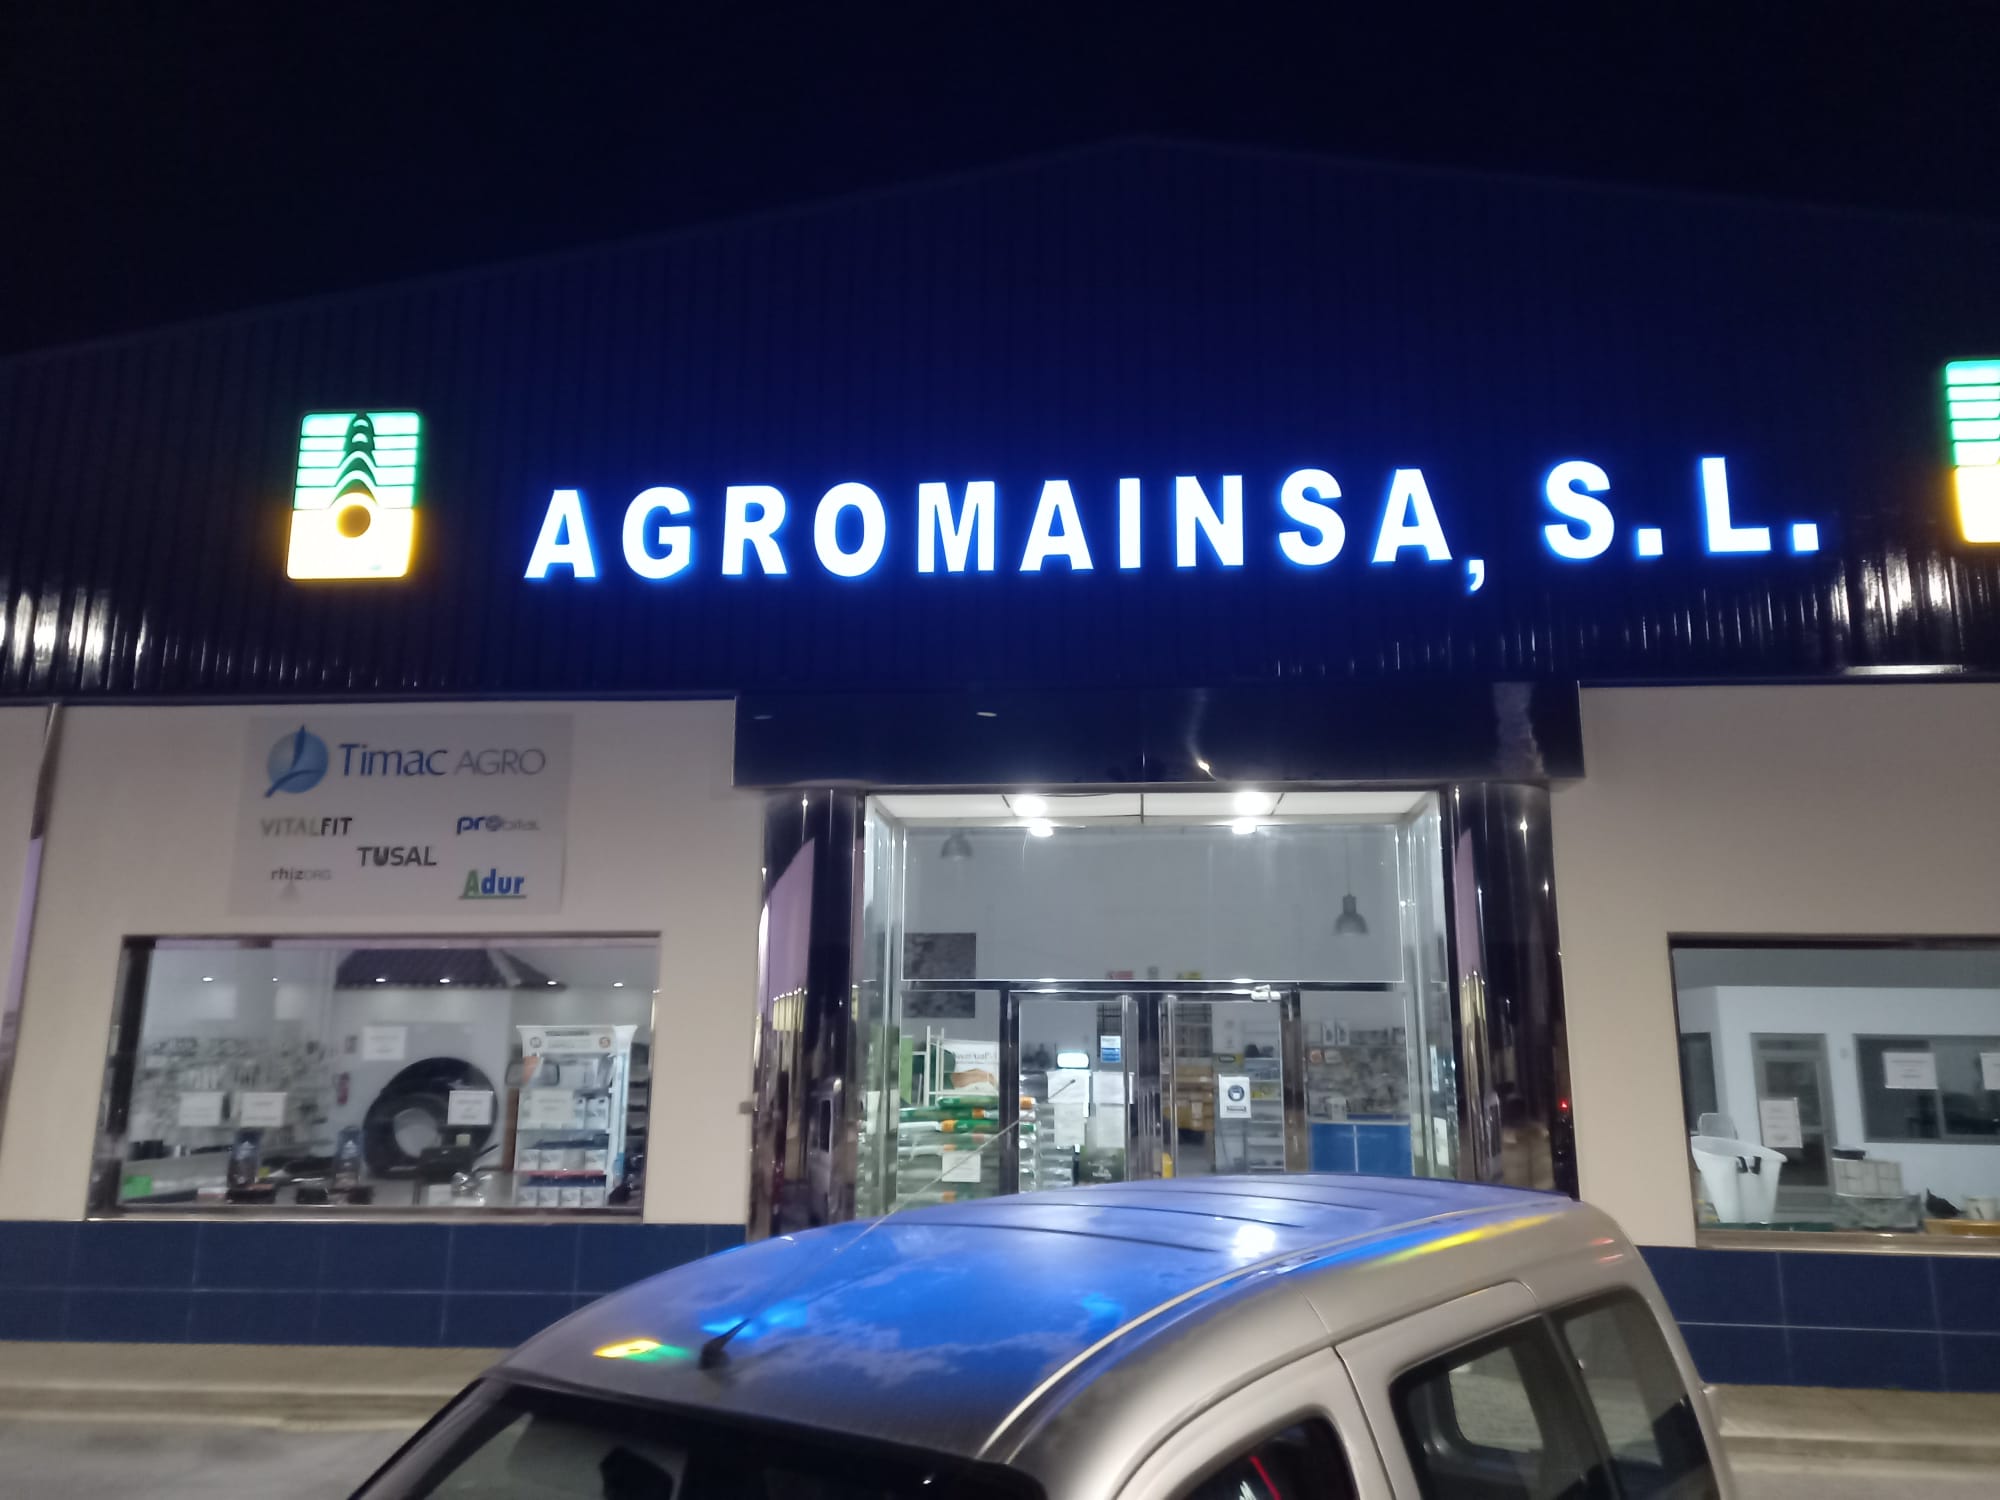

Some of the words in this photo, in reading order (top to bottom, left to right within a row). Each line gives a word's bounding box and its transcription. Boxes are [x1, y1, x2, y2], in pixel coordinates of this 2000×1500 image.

[523, 469, 1485, 592] AGROMAINSA,
[338, 743, 449, 777] Timac
[455, 748, 547, 777] AGRO
[260, 817, 353, 837] VITALFIT
[357, 846, 438, 868] TUSAL
[462, 868, 526, 897] Adur
